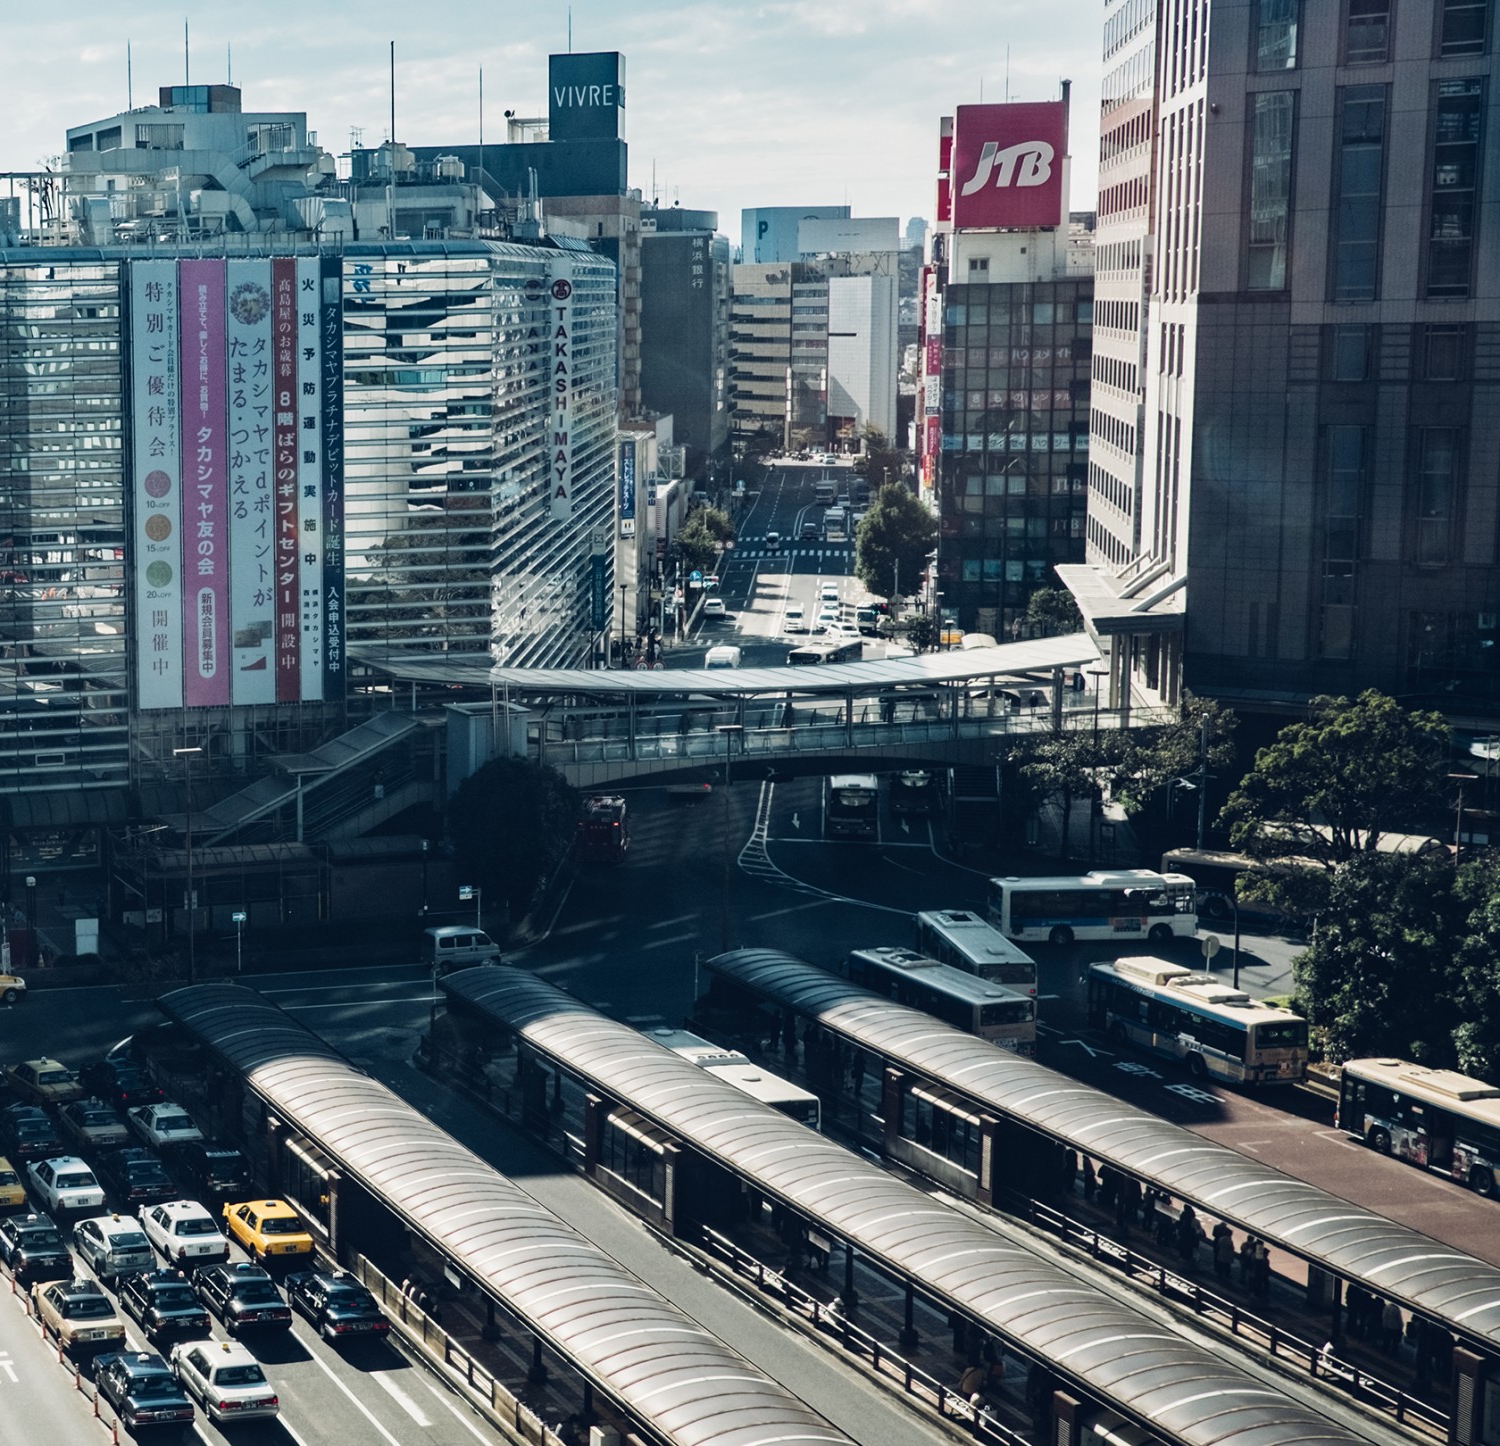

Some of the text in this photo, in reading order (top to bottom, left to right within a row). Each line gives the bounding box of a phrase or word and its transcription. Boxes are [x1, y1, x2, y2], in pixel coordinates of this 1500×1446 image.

[553, 84, 614, 109] VIVRE
[960, 139, 1055, 197] JTB
[691, 237, 705, 290] 横浜銀行
[758, 220, 769, 241] P
[144, 281, 166, 457] 特別ご優待会
[554, 306, 568, 499] TAKASHIMAYA
[229, 336, 251, 520] たまる・つかえる
[302, 278, 317, 566] 火災予防運動実施中
[196, 426, 215, 576] タカシマヤ友の会
[251, 337, 273, 608] タカシマヤでdポイントが
[152, 609, 169, 676] 開催中
[201, 593, 214, 673] 新規会員募集中
[281, 612, 296, 670] 開設中
[327, 586, 340, 673] 入会申込受付中
